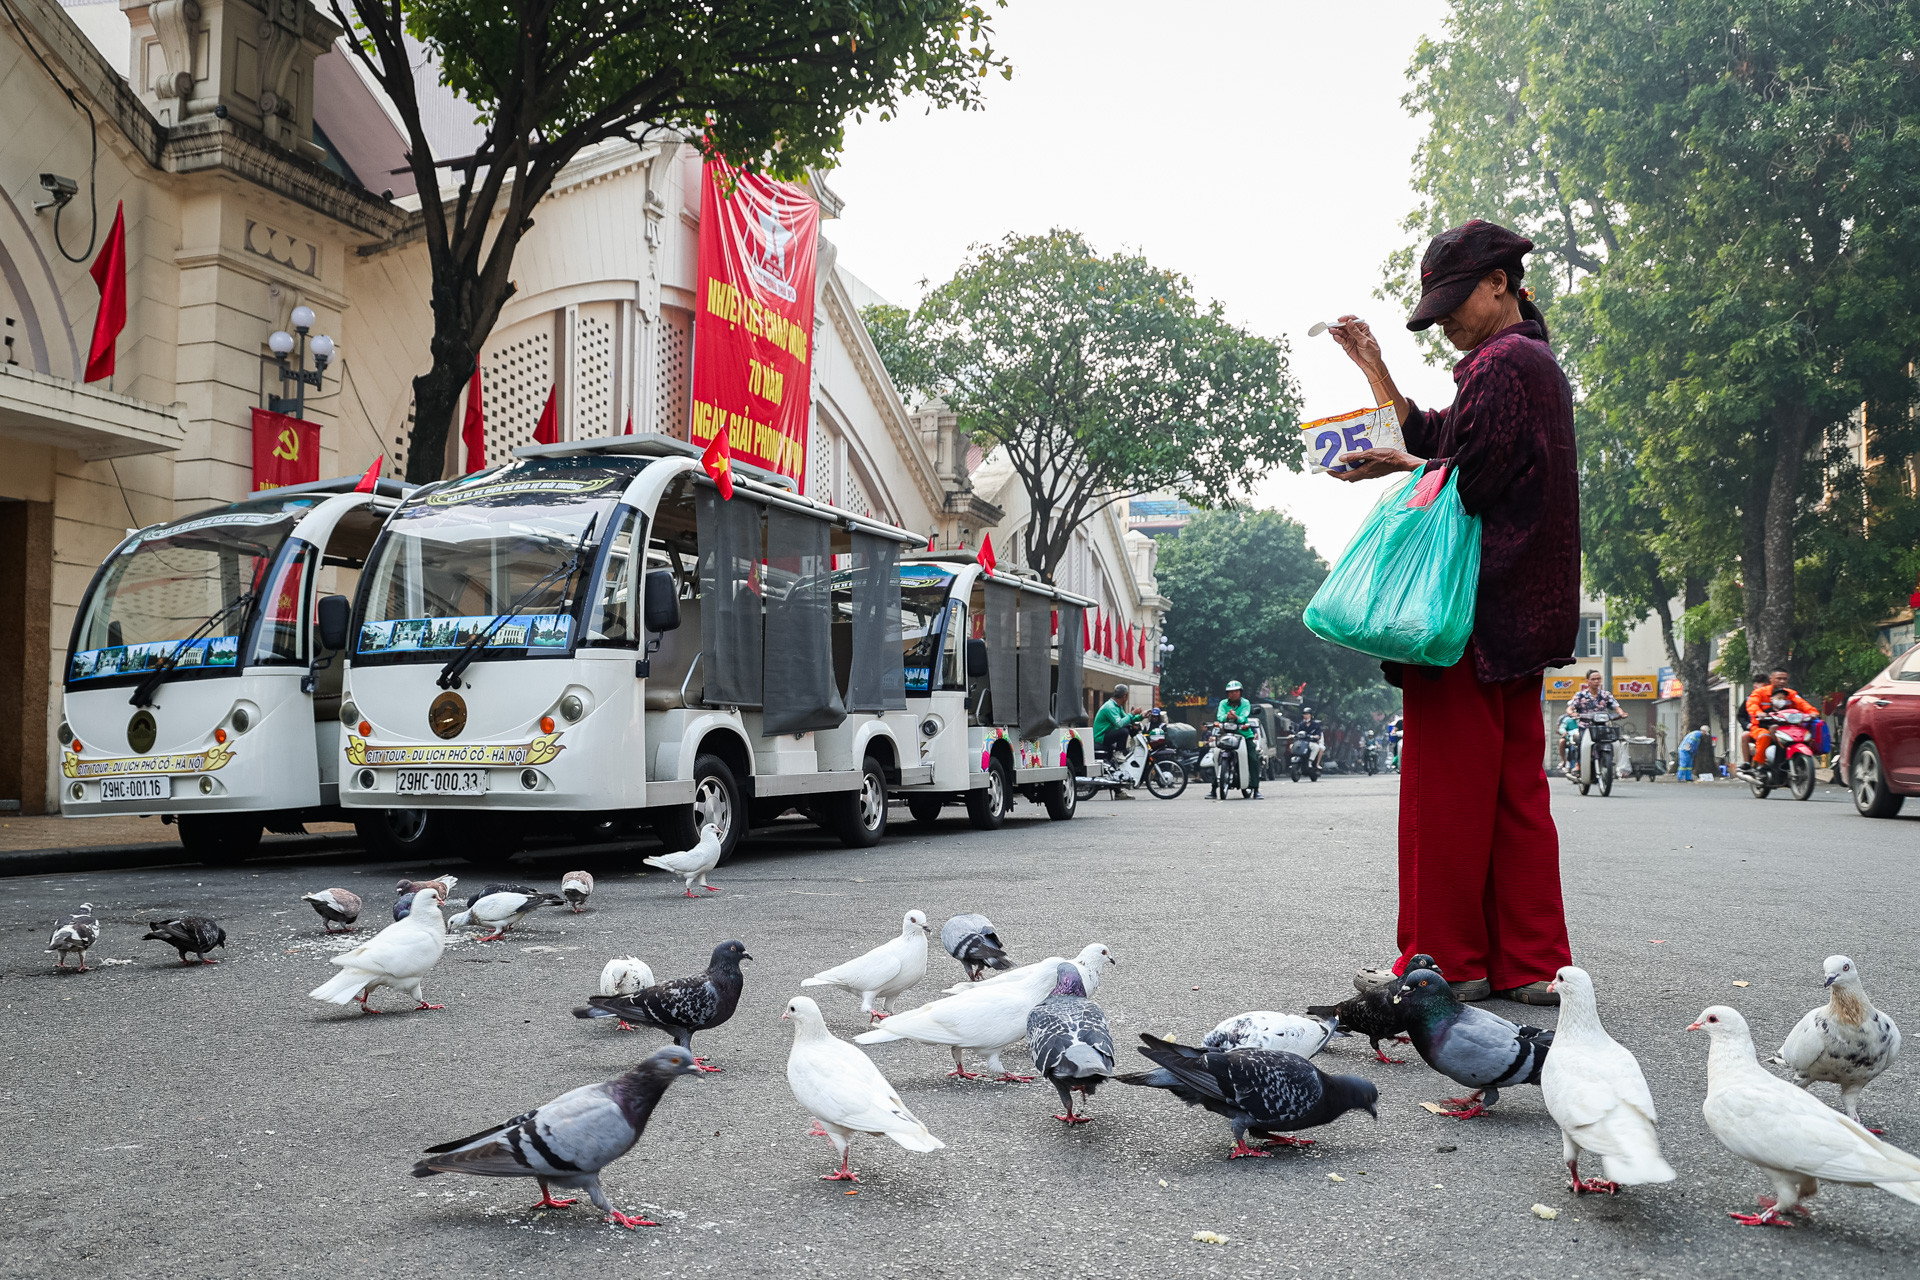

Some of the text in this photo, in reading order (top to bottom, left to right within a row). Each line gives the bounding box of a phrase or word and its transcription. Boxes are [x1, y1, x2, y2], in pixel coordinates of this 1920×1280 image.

[748, 358, 784, 406] 70 NĂM
[692, 398, 728, 441] NGÀY
[728, 405, 754, 453] GIẢI
[1315, 423, 1374, 473] 25
[91, 763, 109, 775] TOUR
[112, 762, 123, 772] DU
[175, 755, 186, 769] HÀ
[366, 750, 384, 763] CITY
[384, 749, 406, 762] TOUR
[411, 749, 424, 761] DU
[426, 749, 448, 764] LỊCH
[448, 745, 472, 761] PHỐ
[491, 746, 505, 761] HÀ
[508, 746, 527, 765] NỘI
